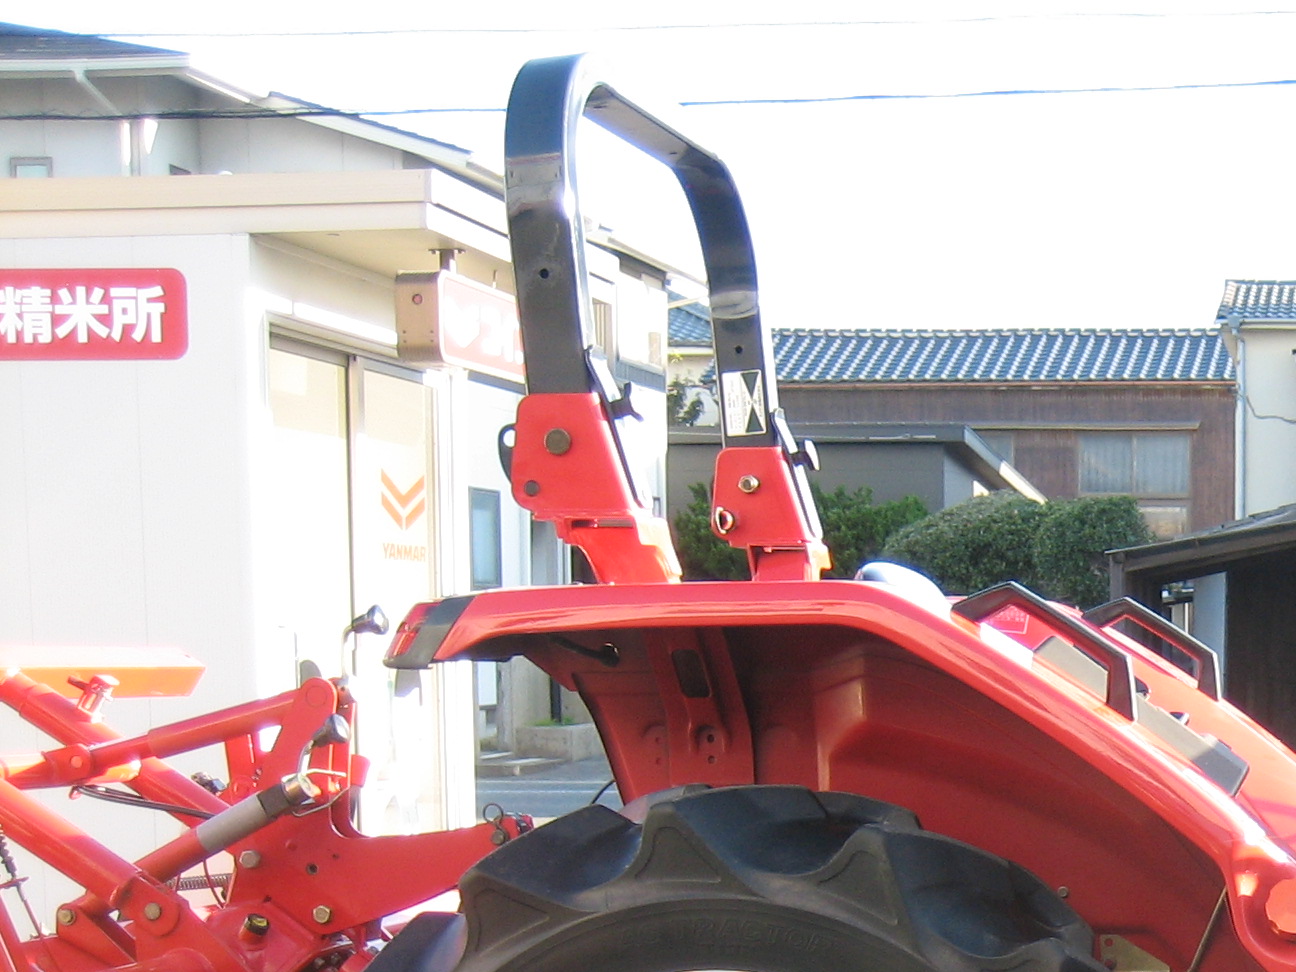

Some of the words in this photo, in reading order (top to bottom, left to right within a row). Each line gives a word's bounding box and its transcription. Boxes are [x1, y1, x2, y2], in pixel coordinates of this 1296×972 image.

[0, 286, 165, 344] 精米所
[383, 542, 427, 562] YANMAR
